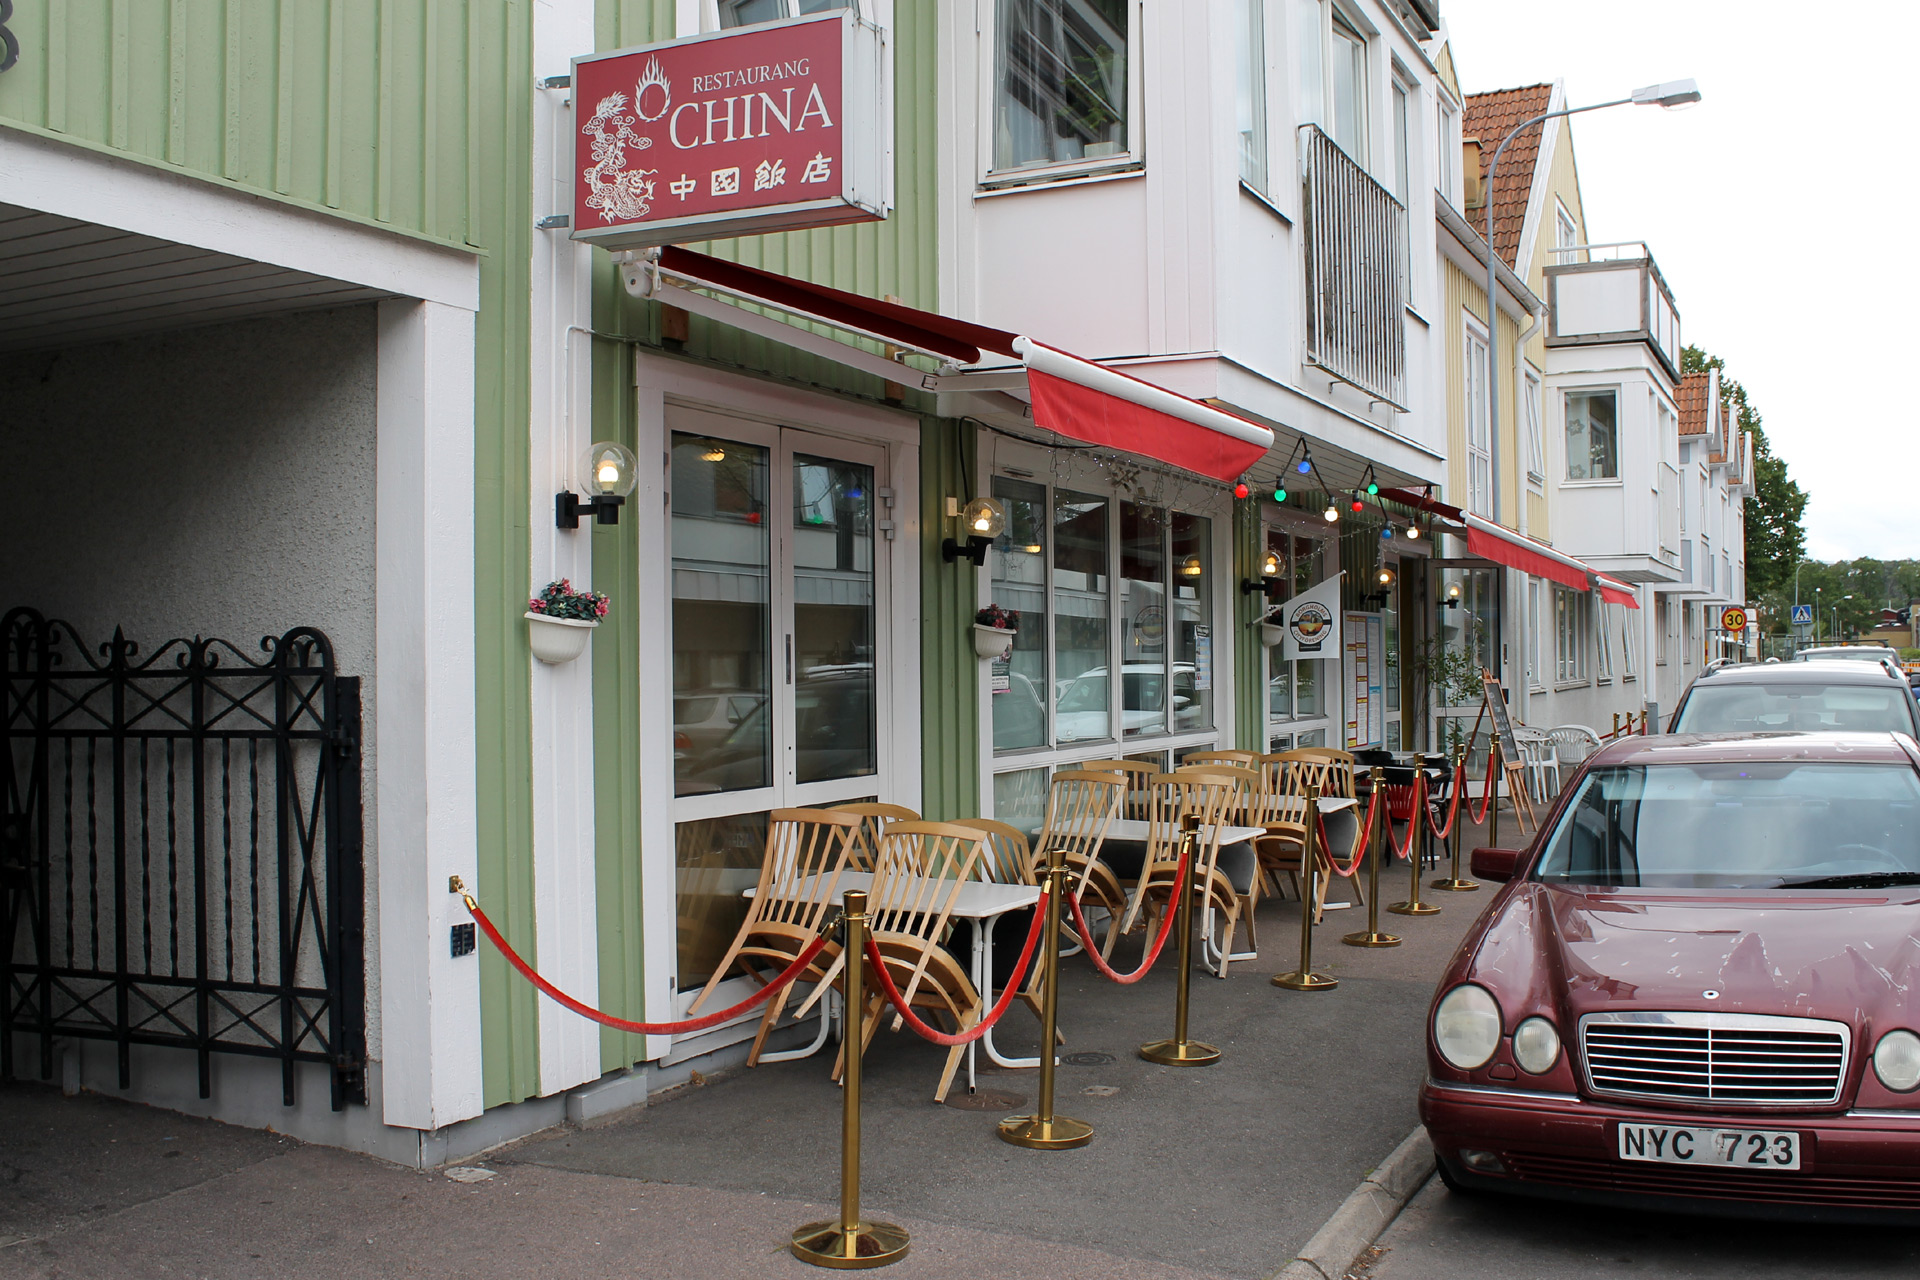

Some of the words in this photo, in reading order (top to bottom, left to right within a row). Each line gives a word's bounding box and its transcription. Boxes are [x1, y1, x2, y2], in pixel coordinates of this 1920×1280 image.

[692, 58, 810, 93] RESTAURANG
[668, 82, 834, 150] CHINA
[1726, 614, 1743, 625] 30
[1624, 1127, 1694, 1160] NYC
[1721, 1133, 1793, 1165] 723
